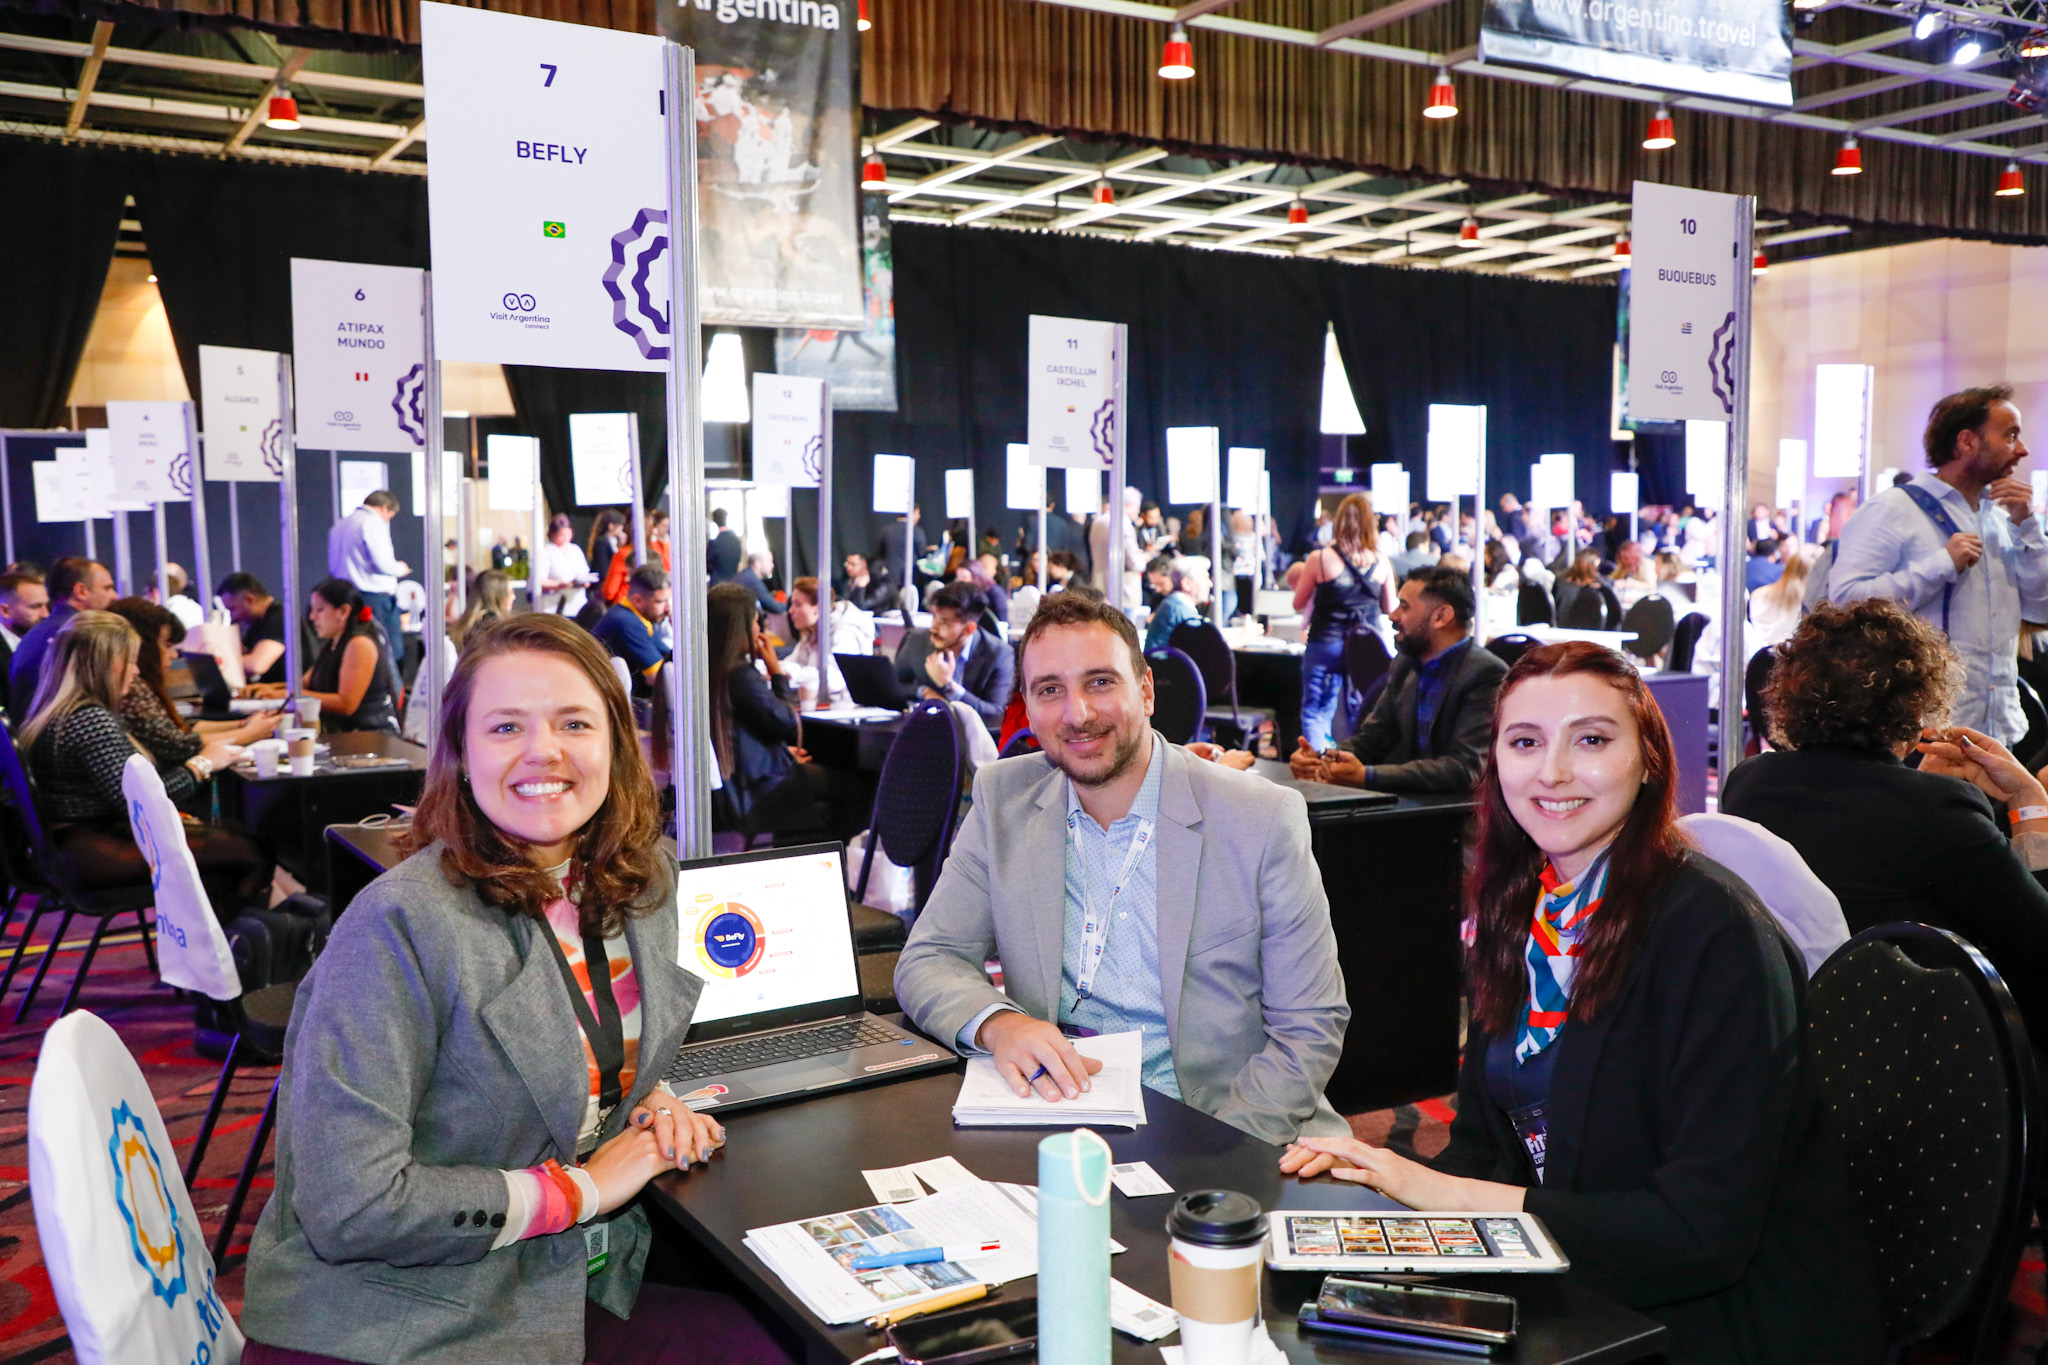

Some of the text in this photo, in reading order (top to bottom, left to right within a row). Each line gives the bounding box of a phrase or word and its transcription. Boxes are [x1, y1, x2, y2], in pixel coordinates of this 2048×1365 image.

[677, 0, 840, 30] gentina
[540, 63, 557, 88] 7
[516, 140, 588, 165] BEFLY
[1679, 217, 1697, 236] 10
[1658, 268, 1717, 286] BUQUEBUS
[354, 287, 366, 301] 6
[489, 312, 551, 323] Visit Argentina
[337, 321, 385, 335] ATIPAX
[337, 337, 385, 350] MUNDO
[1066, 338, 1078, 350] 11
[1046, 364, 1097, 377] CASTELLUM
[1056, 377, 1087, 388] IXCHEL
[725, 933, 745, 942] BeFly
